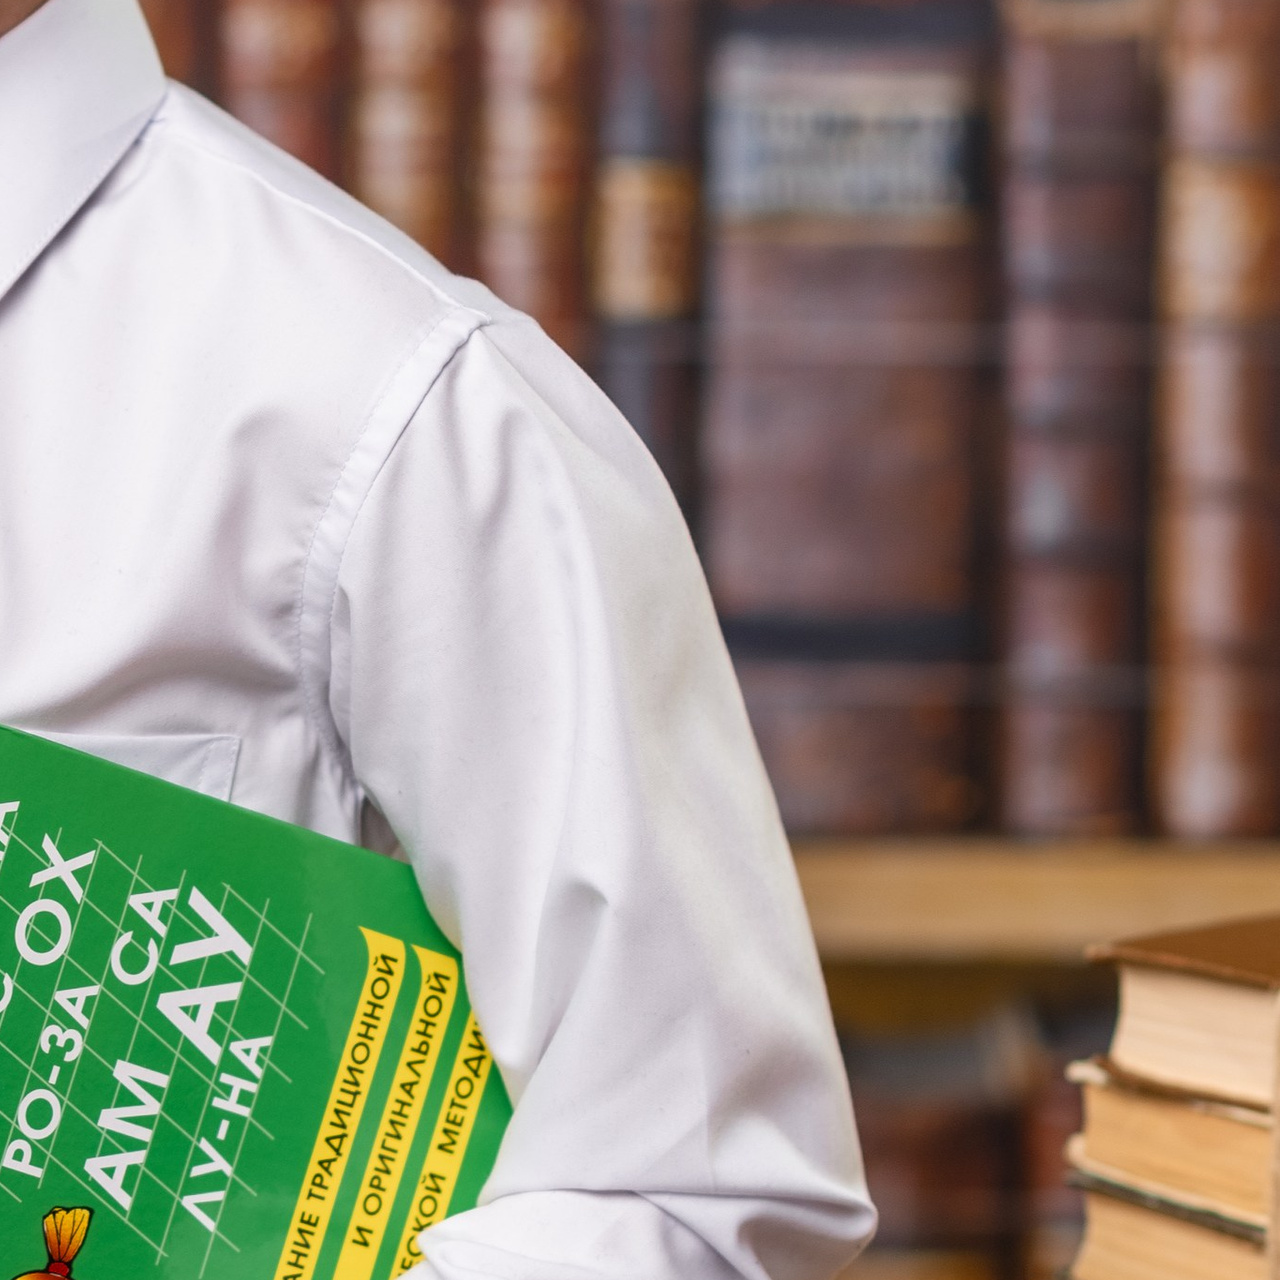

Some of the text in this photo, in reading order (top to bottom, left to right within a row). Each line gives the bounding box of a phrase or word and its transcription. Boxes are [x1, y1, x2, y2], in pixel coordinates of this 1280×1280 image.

[15, 833, 96, 965] ОХ
[110, 888, 180, 985] СА
[156, 886, 253, 1065] АУ
[2, 984, 101, 1178] РО-ЗА
[83, 1059, 170, 1211] АМ
[181, 1035, 274, 1233] ЛУ-НА
[307, 953, 400, 1203] ТРАДИЦИОННОЙ
[351, 970, 452, 1249] И ОРИГИНАЛЬНОЙ
[397, 1021, 487, 1277] ЕСКОЙ МЕТОДИ
